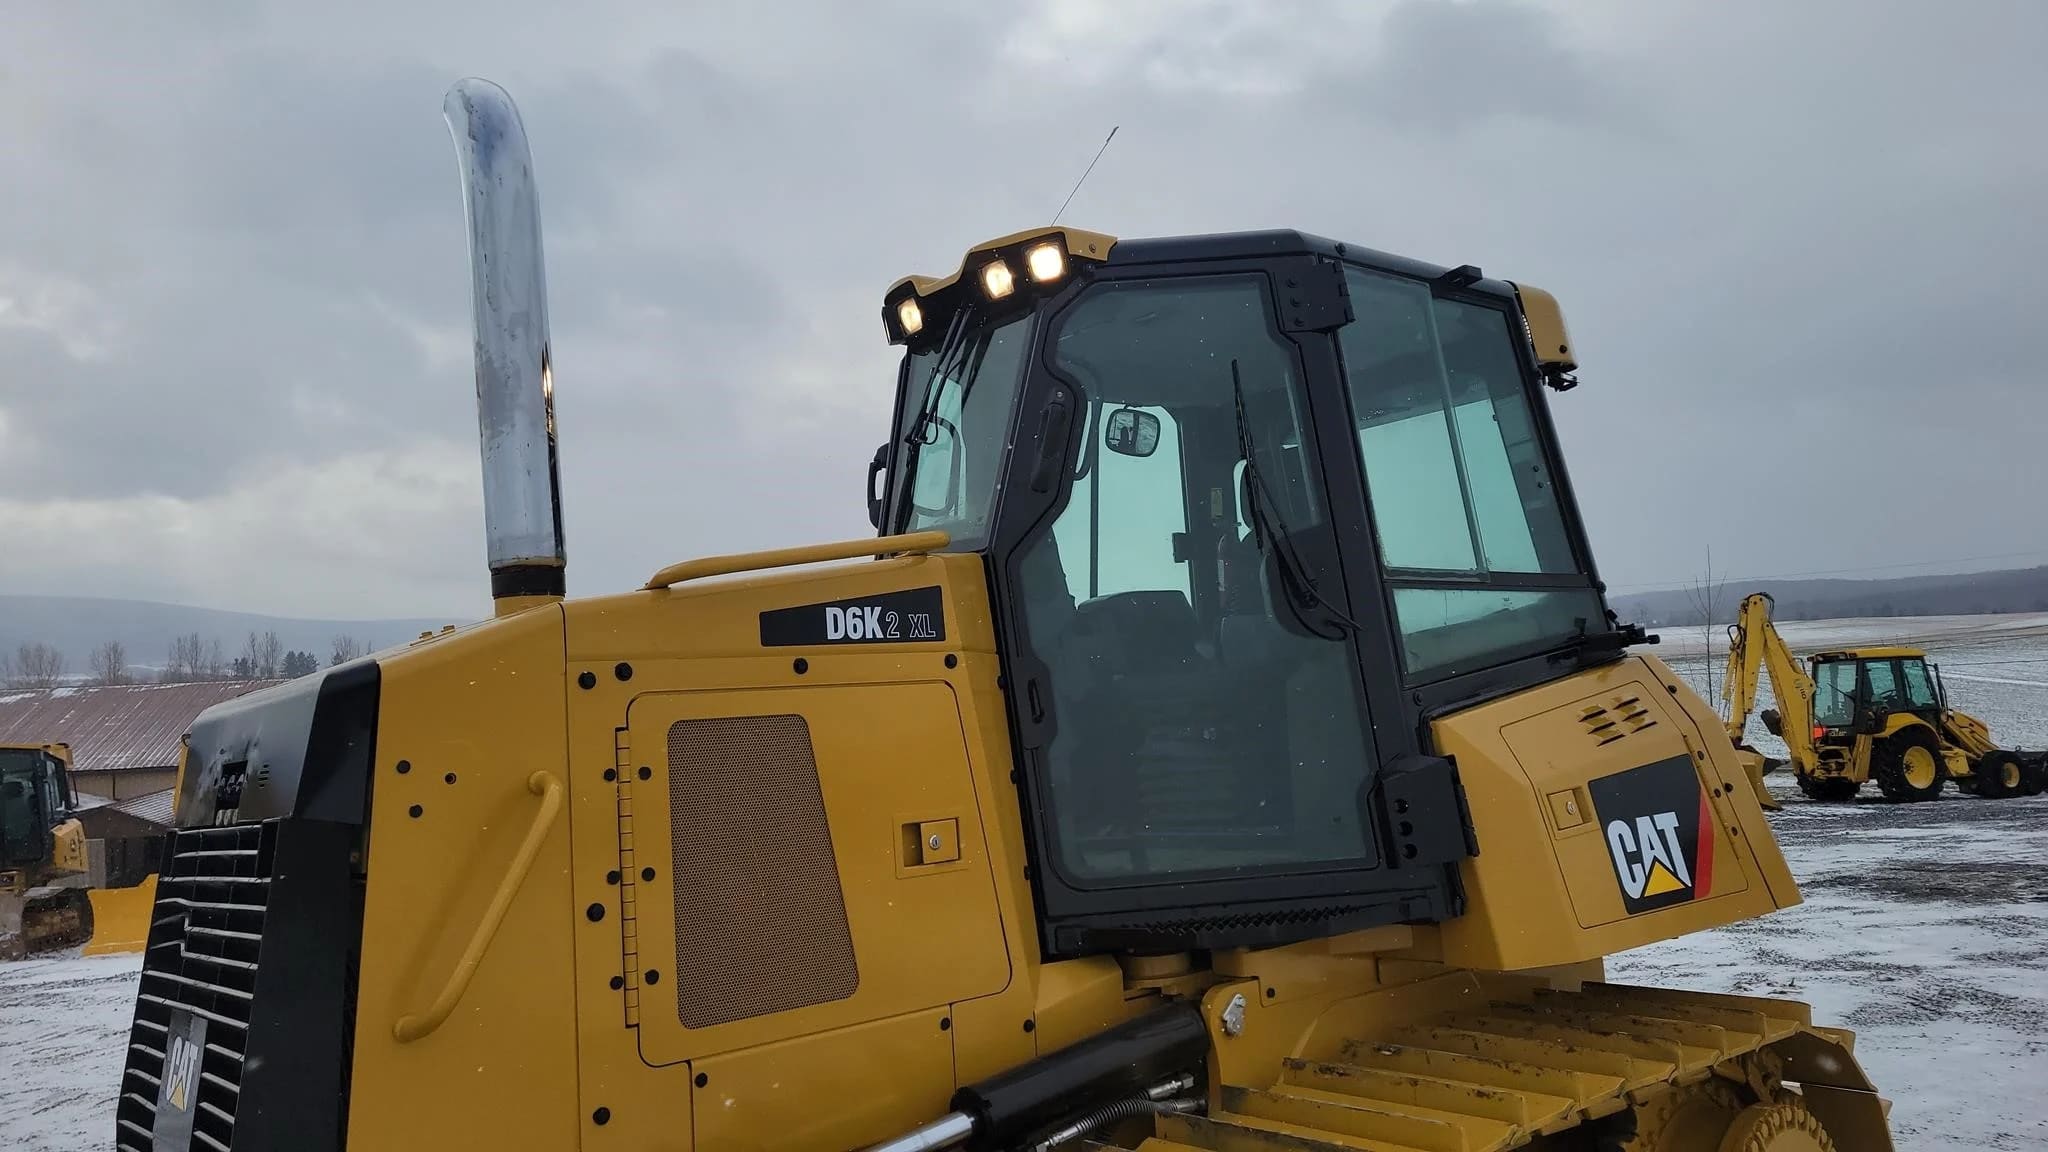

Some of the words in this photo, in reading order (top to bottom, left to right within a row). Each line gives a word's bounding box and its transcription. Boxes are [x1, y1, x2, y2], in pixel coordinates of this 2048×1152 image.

[908, 613, 936, 638] XL
[1607, 811, 1692, 899] CAT
[166, 1036, 199, 1112] CAT
